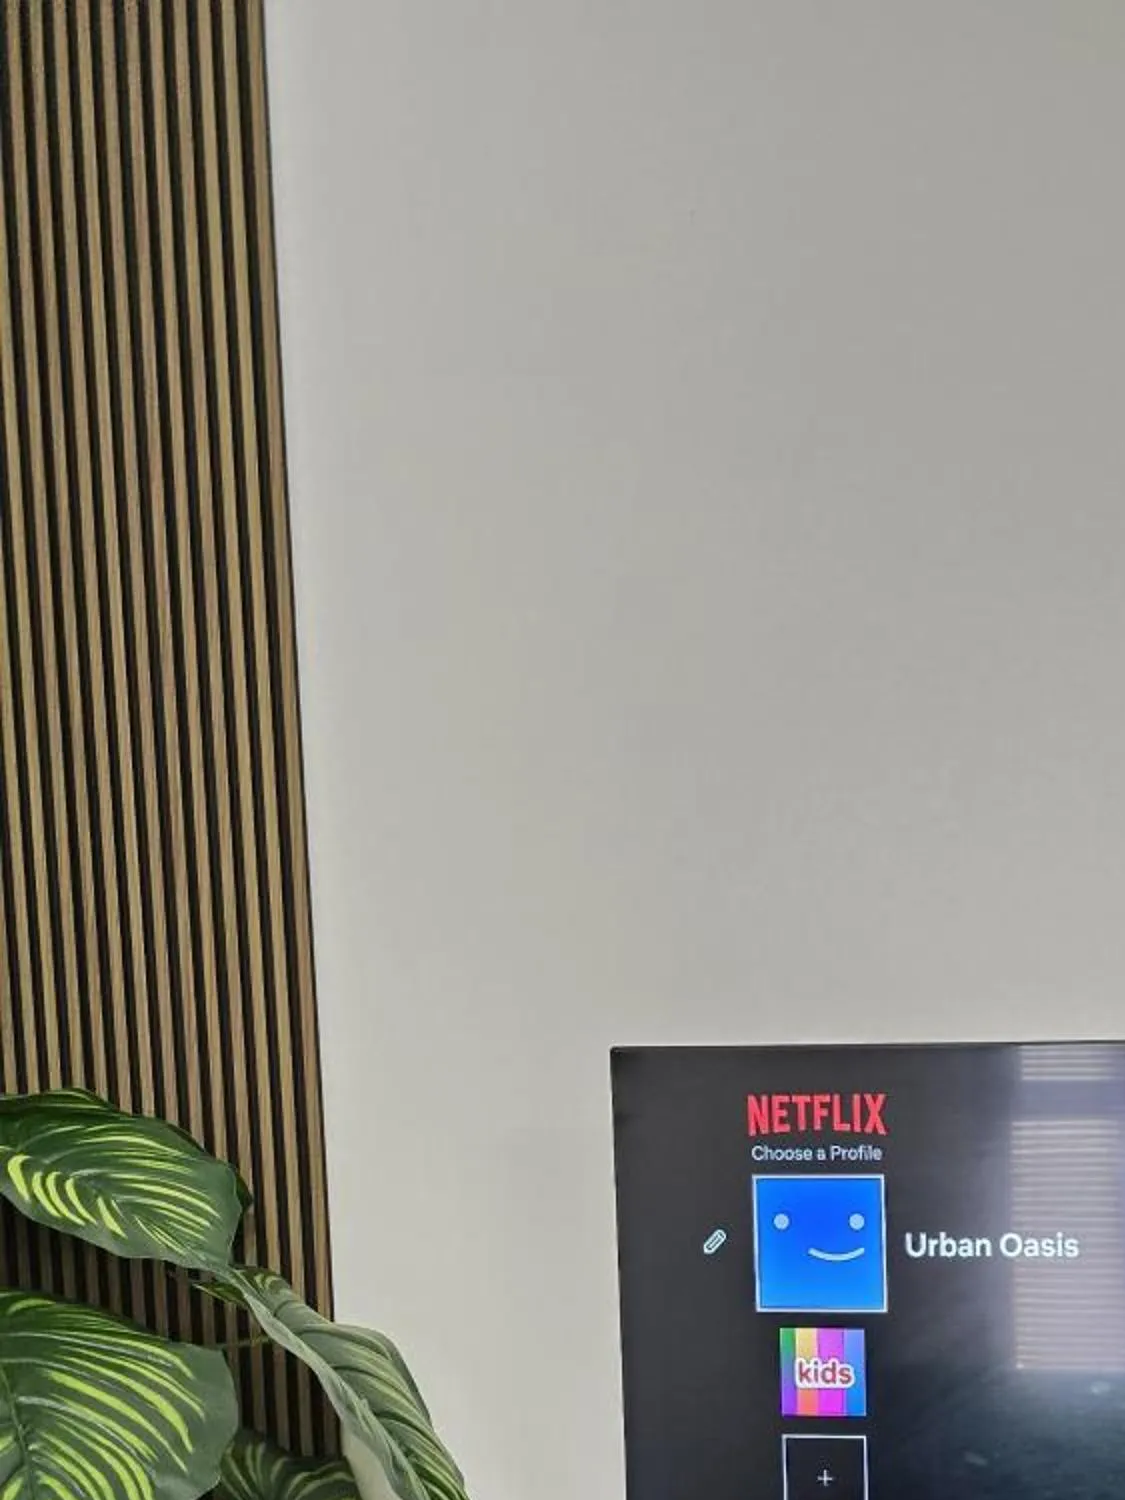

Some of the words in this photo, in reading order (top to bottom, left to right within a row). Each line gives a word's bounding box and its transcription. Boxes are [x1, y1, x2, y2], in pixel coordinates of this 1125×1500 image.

[747, 1093, 887, 1136] NETFLIX
[751, 1145, 813, 1161] Choose
[817, 1149, 826, 1161] a
[831, 1145, 883, 1161] Profile
[905, 1232, 992, 1257] Urban
[1000, 1233, 1080, 1258] Oasis
[796, 1359, 855, 1387] kids
